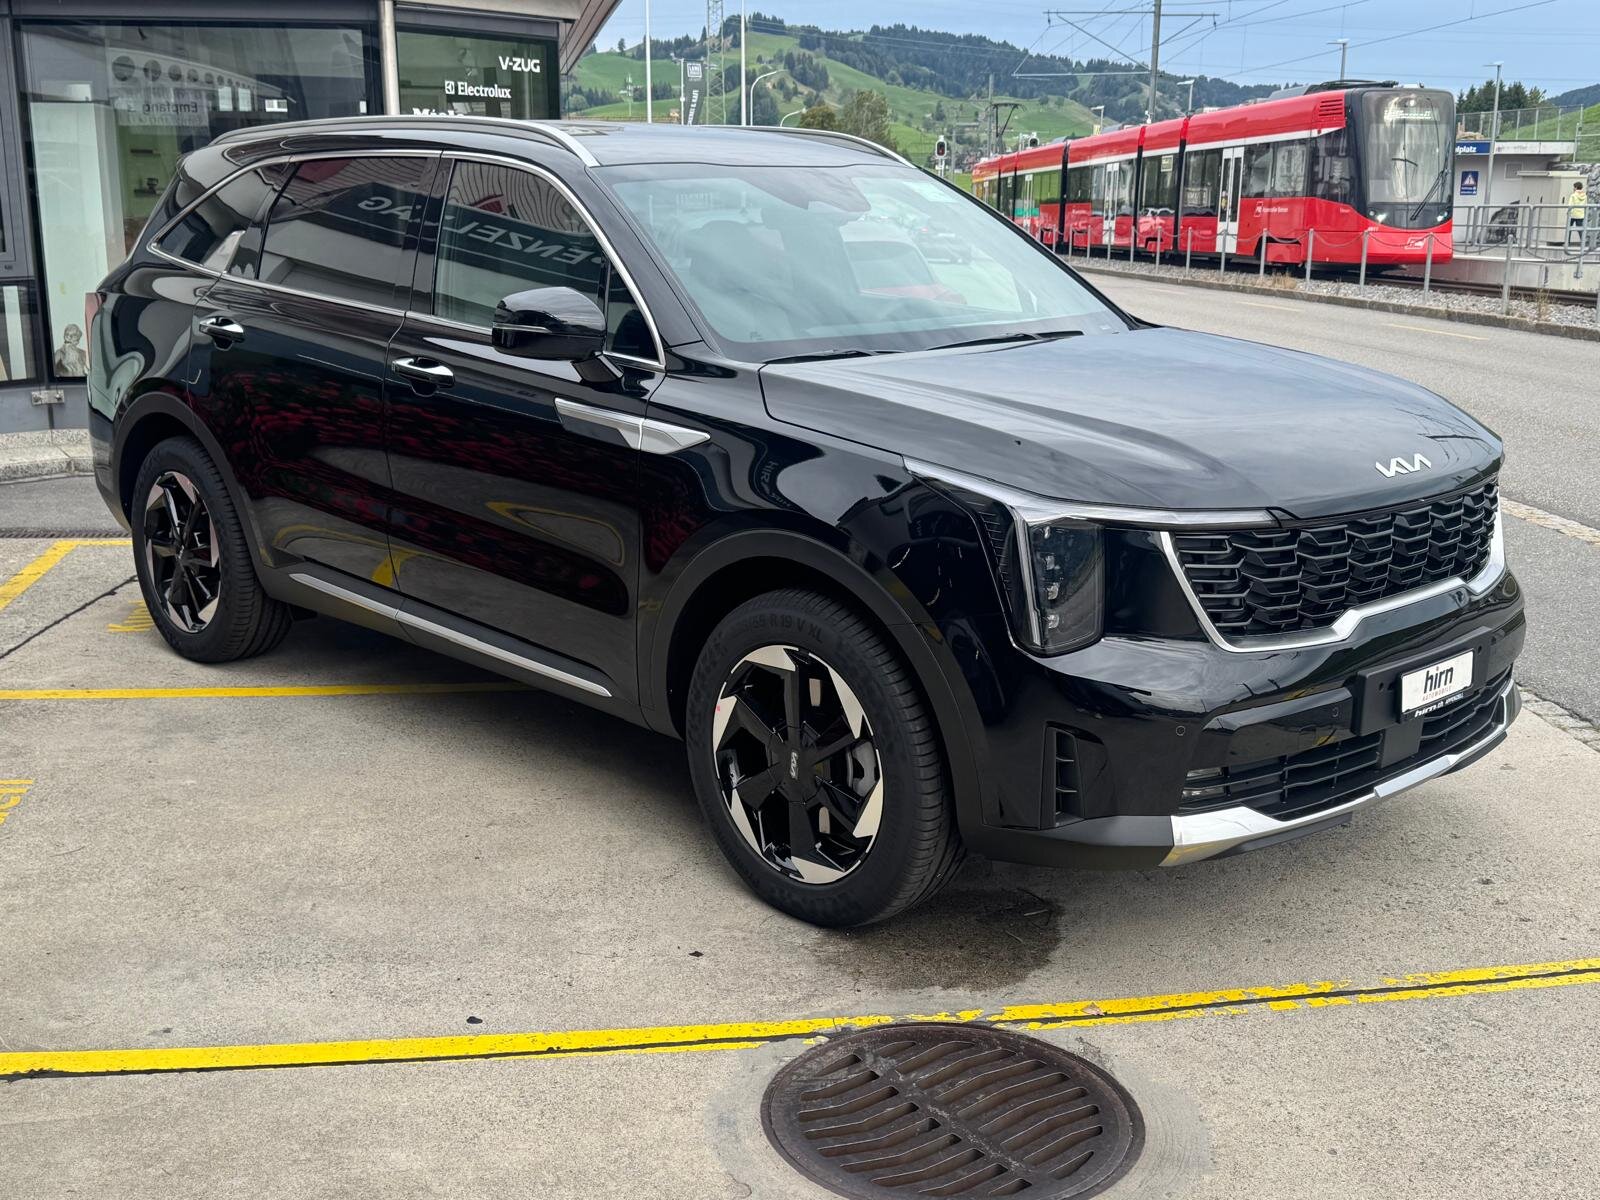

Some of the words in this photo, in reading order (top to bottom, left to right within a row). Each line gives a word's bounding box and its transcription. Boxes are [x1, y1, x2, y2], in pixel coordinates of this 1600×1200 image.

[499, 56, 540, 73] V-ZUG
[457, 81, 512, 99] Electrolux
[1375, 452, 1432, 478] KIA
[1424, 666, 1454, 694] hirn
